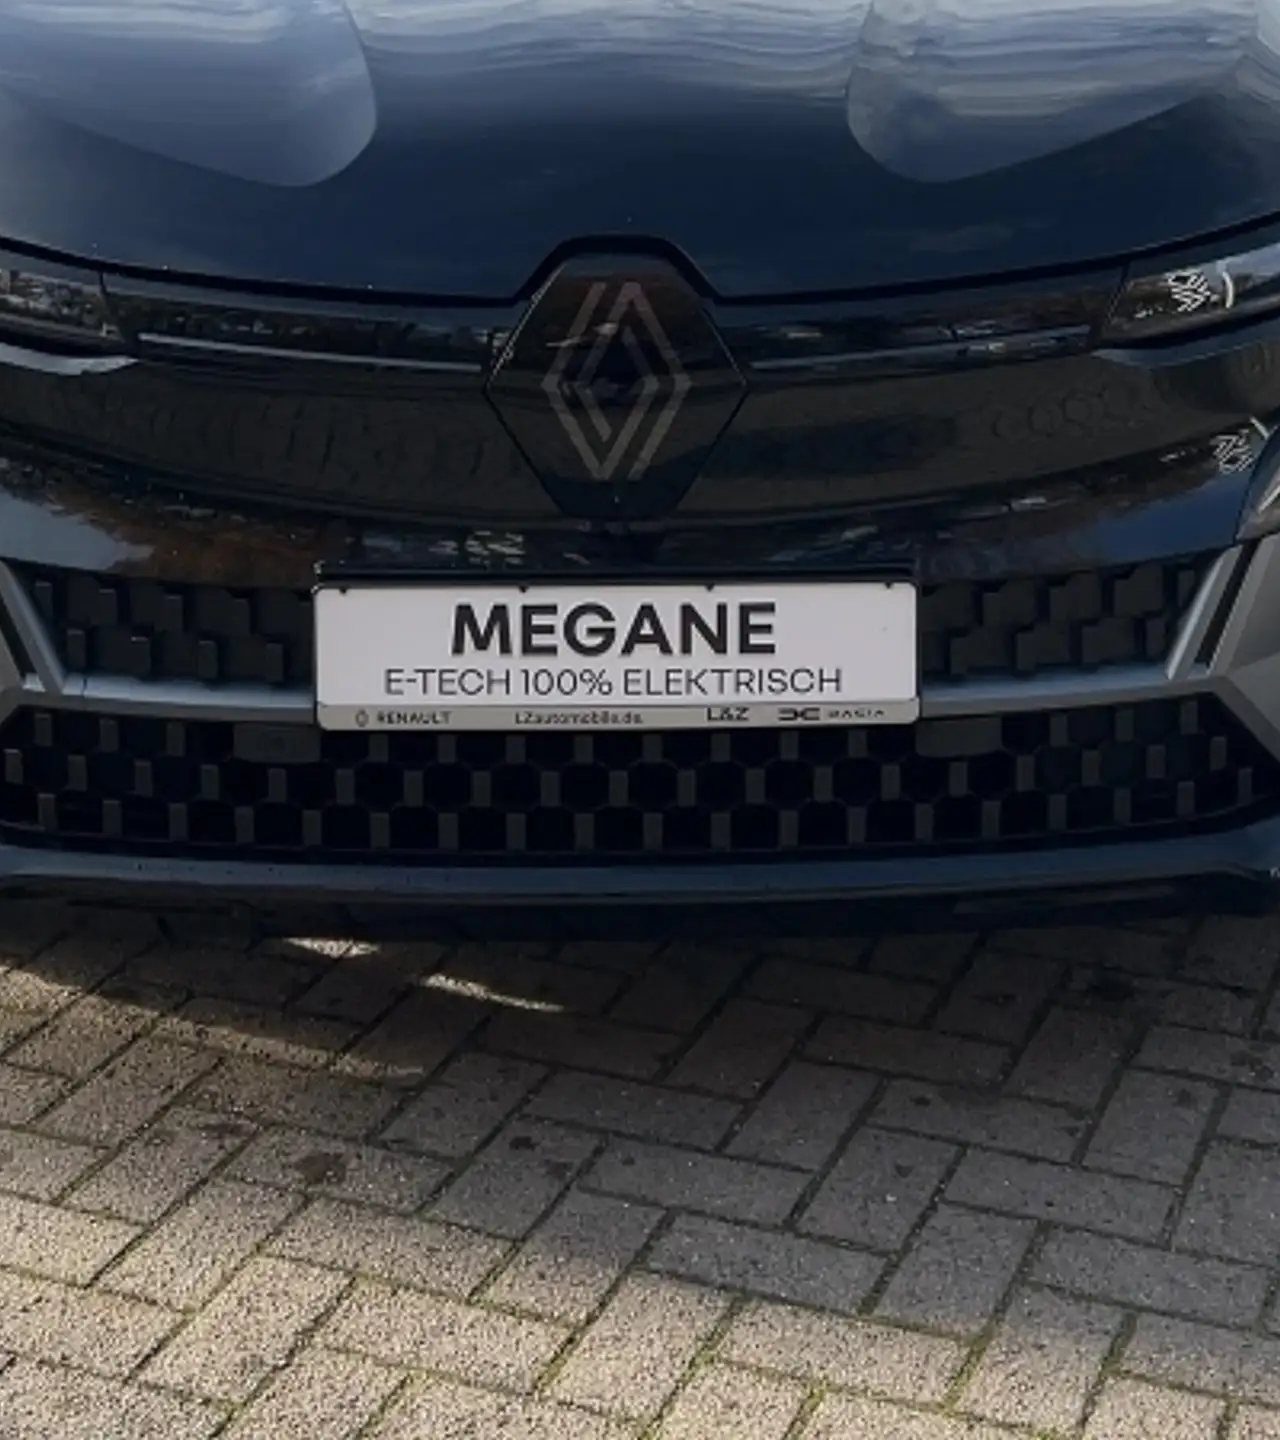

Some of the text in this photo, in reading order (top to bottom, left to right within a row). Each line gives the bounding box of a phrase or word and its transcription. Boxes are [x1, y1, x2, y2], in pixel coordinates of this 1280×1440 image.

[451, 602, 776, 658] MEGANE
[385, 667, 843, 697] E-TECH 100% ELEKTRISCH
[376, 711, 451, 725] RENAULT
[706, 707, 750, 721] L&Z
